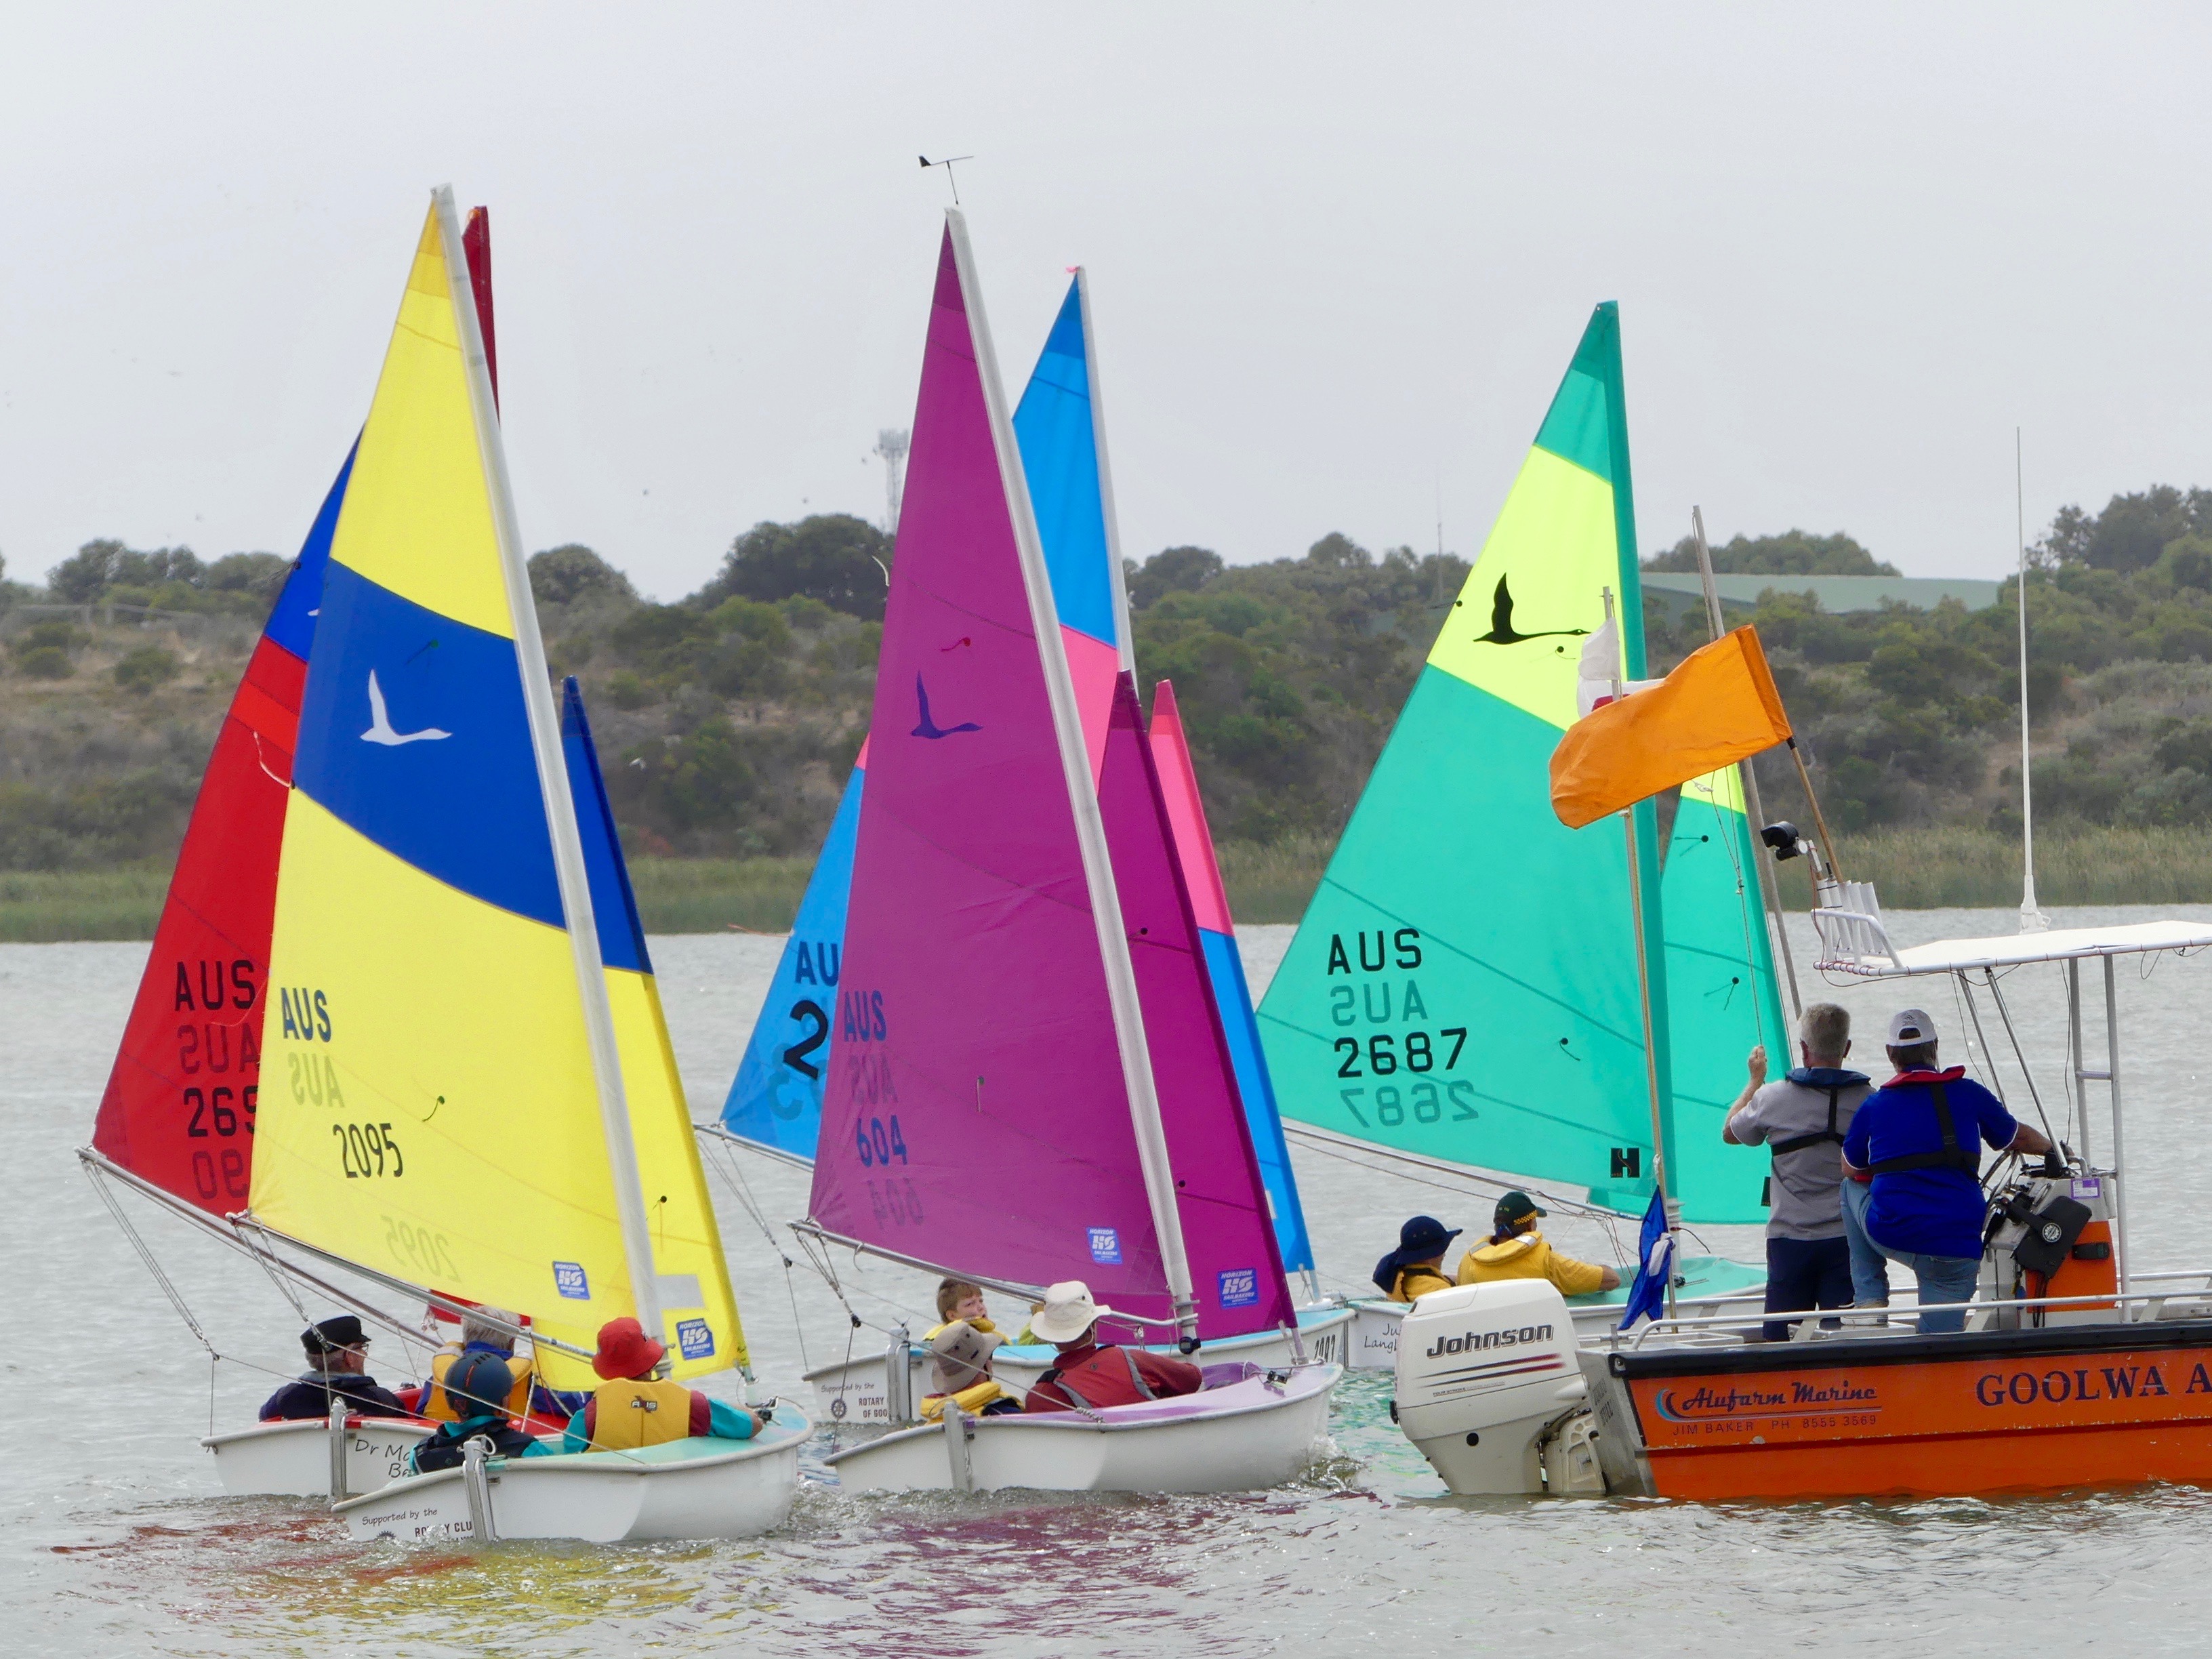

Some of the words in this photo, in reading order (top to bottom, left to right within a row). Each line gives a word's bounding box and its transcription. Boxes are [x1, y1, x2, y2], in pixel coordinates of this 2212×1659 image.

[795, 941, 838, 987] AU
[1328, 928, 1422, 975] AUS
[175, 960, 255, 1011] AUS
[281, 987, 332, 1043] AUS
[844, 990, 886, 1042] AUS
[1334, 1027, 1468, 1079] 2687
[184, 1085, 259, 1138] 269
[333, 1122, 404, 1179] 2095
[857, 1115, 907, 1168] 604
[1221, 1270, 1253, 1279] HORIZON
[1426, 1324, 1554, 1359] Johnson
[858, 1397, 884, 1407] ROTARY
[1681, 1387, 1786, 1412] Alufarm
[1790, 1380, 1878, 1404] Marine
[1975, 1365, 2169, 1407] GOOLWA
[2185, 1362, 2212, 1394] A
[863, 1410, 872, 1418] OF
[874, 1409, 888, 1418] GOO
[1673, 1423, 1698, 1436] JIM
[1705, 1420, 1755, 1434] BAKER
[1802, 1417, 1837, 1429] 8555
[354, 1439, 380, 1455] Dr
[362, 1511, 406, 1526] Supported
[409, 1511, 419, 1520] by
[424, 1508, 437, 1517] the
[454, 1521, 472, 1533] CLU
